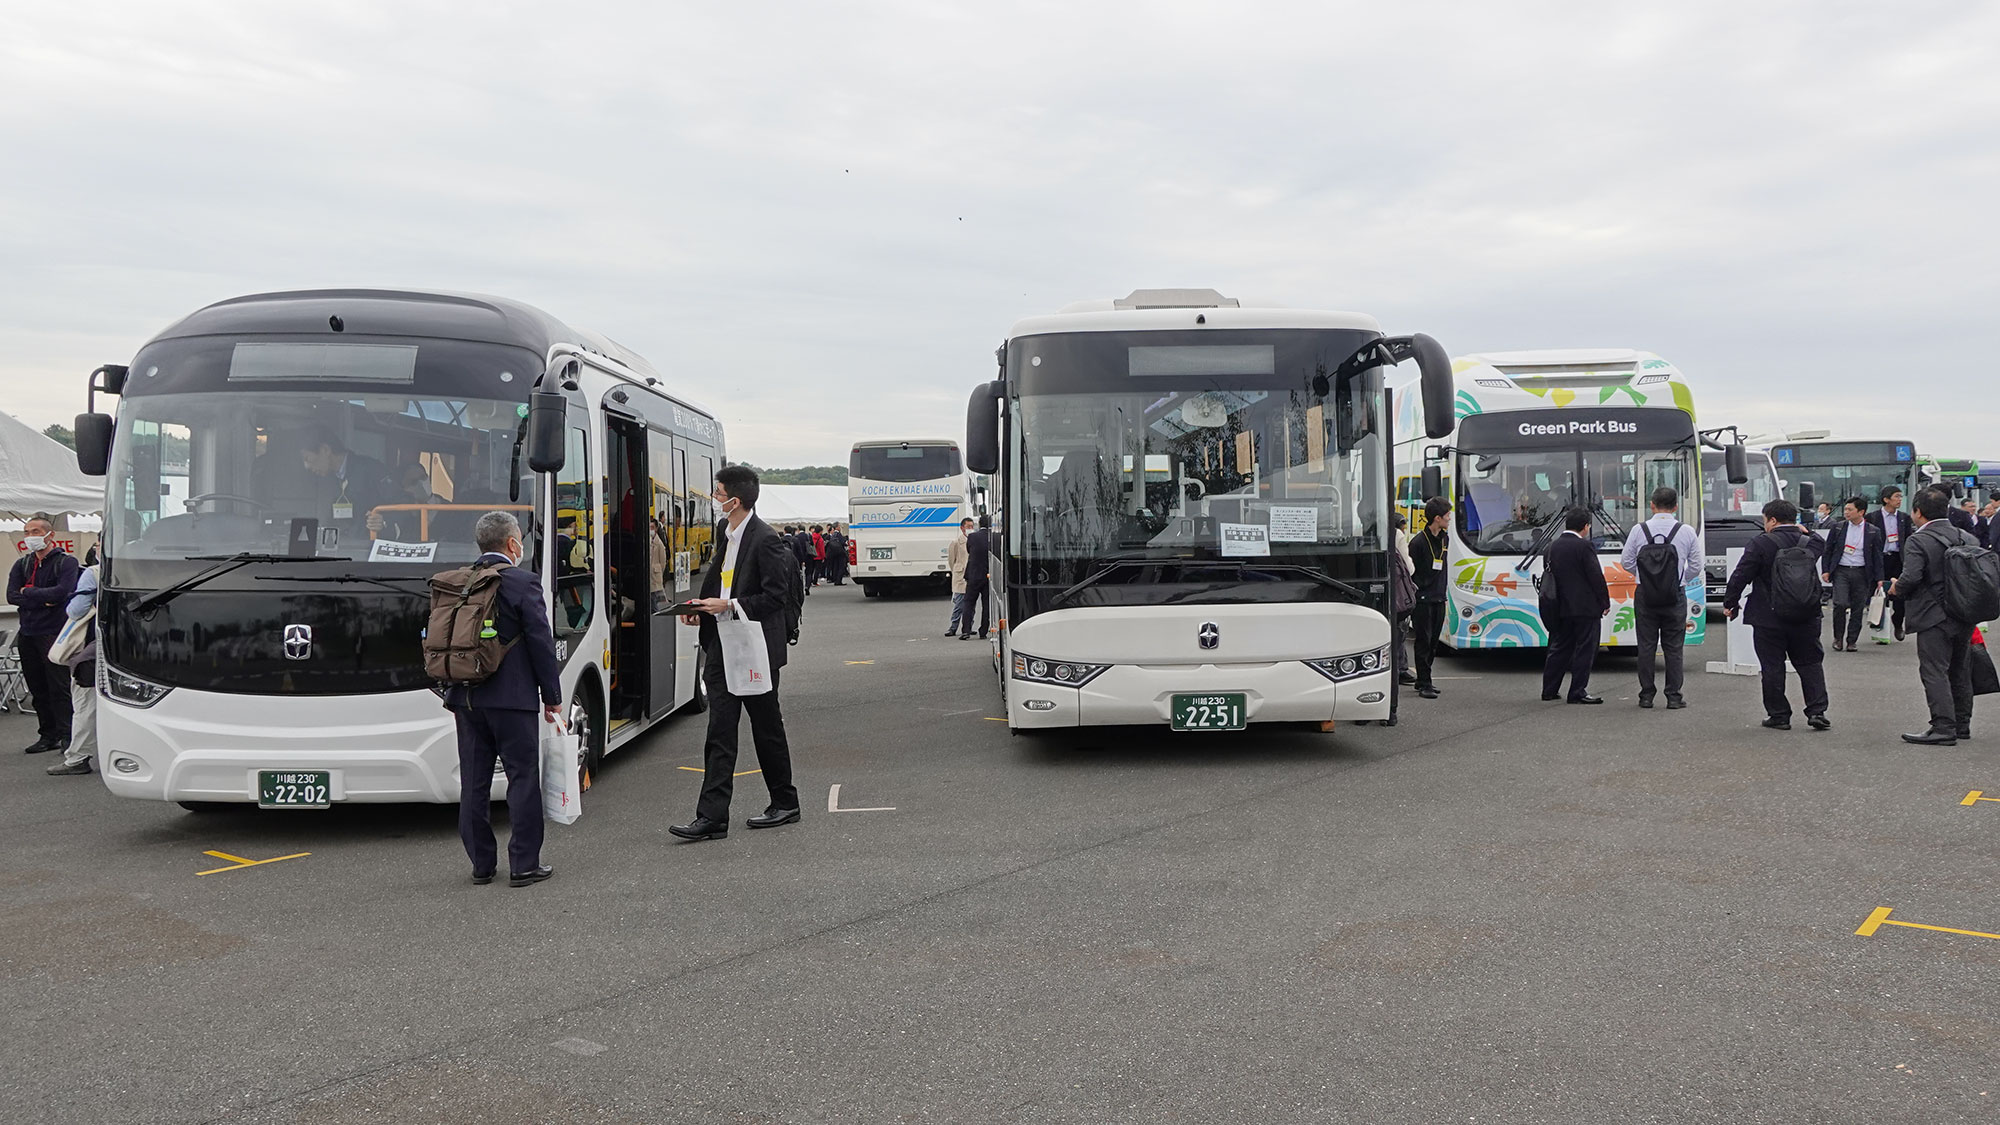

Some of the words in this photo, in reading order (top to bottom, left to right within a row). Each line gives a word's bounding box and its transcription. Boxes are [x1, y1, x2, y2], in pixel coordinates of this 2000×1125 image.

[1518, 423, 1566, 436] Green
[1569, 421, 1606, 434] Park
[1608, 420, 1637, 433] Bus
[862, 486, 888, 496] KOCHI
[889, 485, 921, 495] EKIMAE
[923, 484, 951, 494] KANKO
[1186, 705, 1238, 727] 22-51
[275, 785, 326, 803] 22-02
